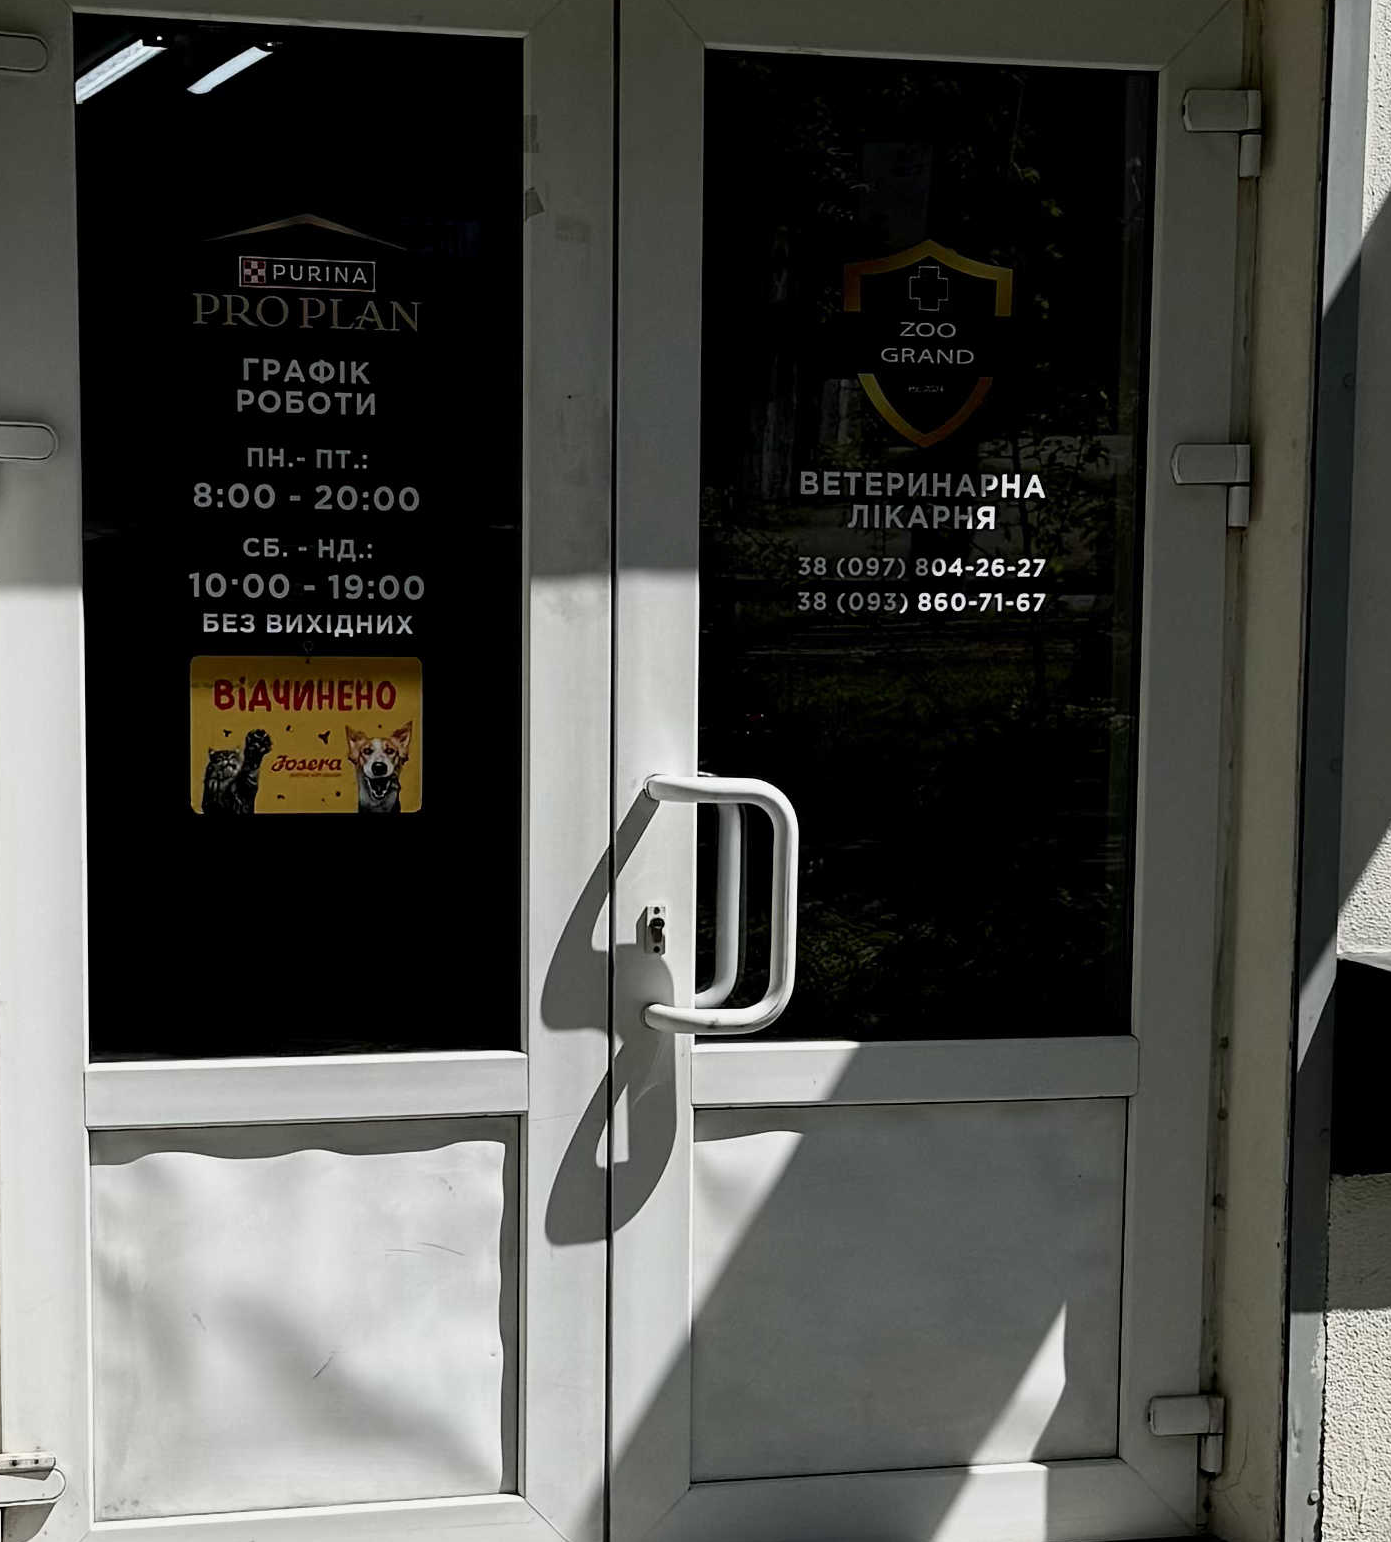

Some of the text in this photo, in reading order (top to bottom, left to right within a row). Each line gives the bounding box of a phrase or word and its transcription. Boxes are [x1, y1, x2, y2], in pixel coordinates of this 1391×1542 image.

[272, 264, 368, 285] PURINA
[899, 321, 957, 338] ZOO
[880, 347, 975, 365] GRAND
[242, 357, 371, 385] ГРАФІК
[236, 388, 376, 416] РОБОТИ
[193, 482, 276, 509] 8:00
[314, 484, 420, 511] 20:00
[799, 470, 1047, 499] ВЕТЕРИНАРНА
[847, 504, 996, 530] ЛІКАРНЯ
[797, 556, 1047, 579] 38 (097) 804-26-27
[327, 574, 425, 601] 19:00
[797, 591, 1047, 614] 38 (093) 860-71-67
[203, 613, 414, 637] БЕЗ ВИХІДНИХ
[270, 754, 343, 773] Josera
